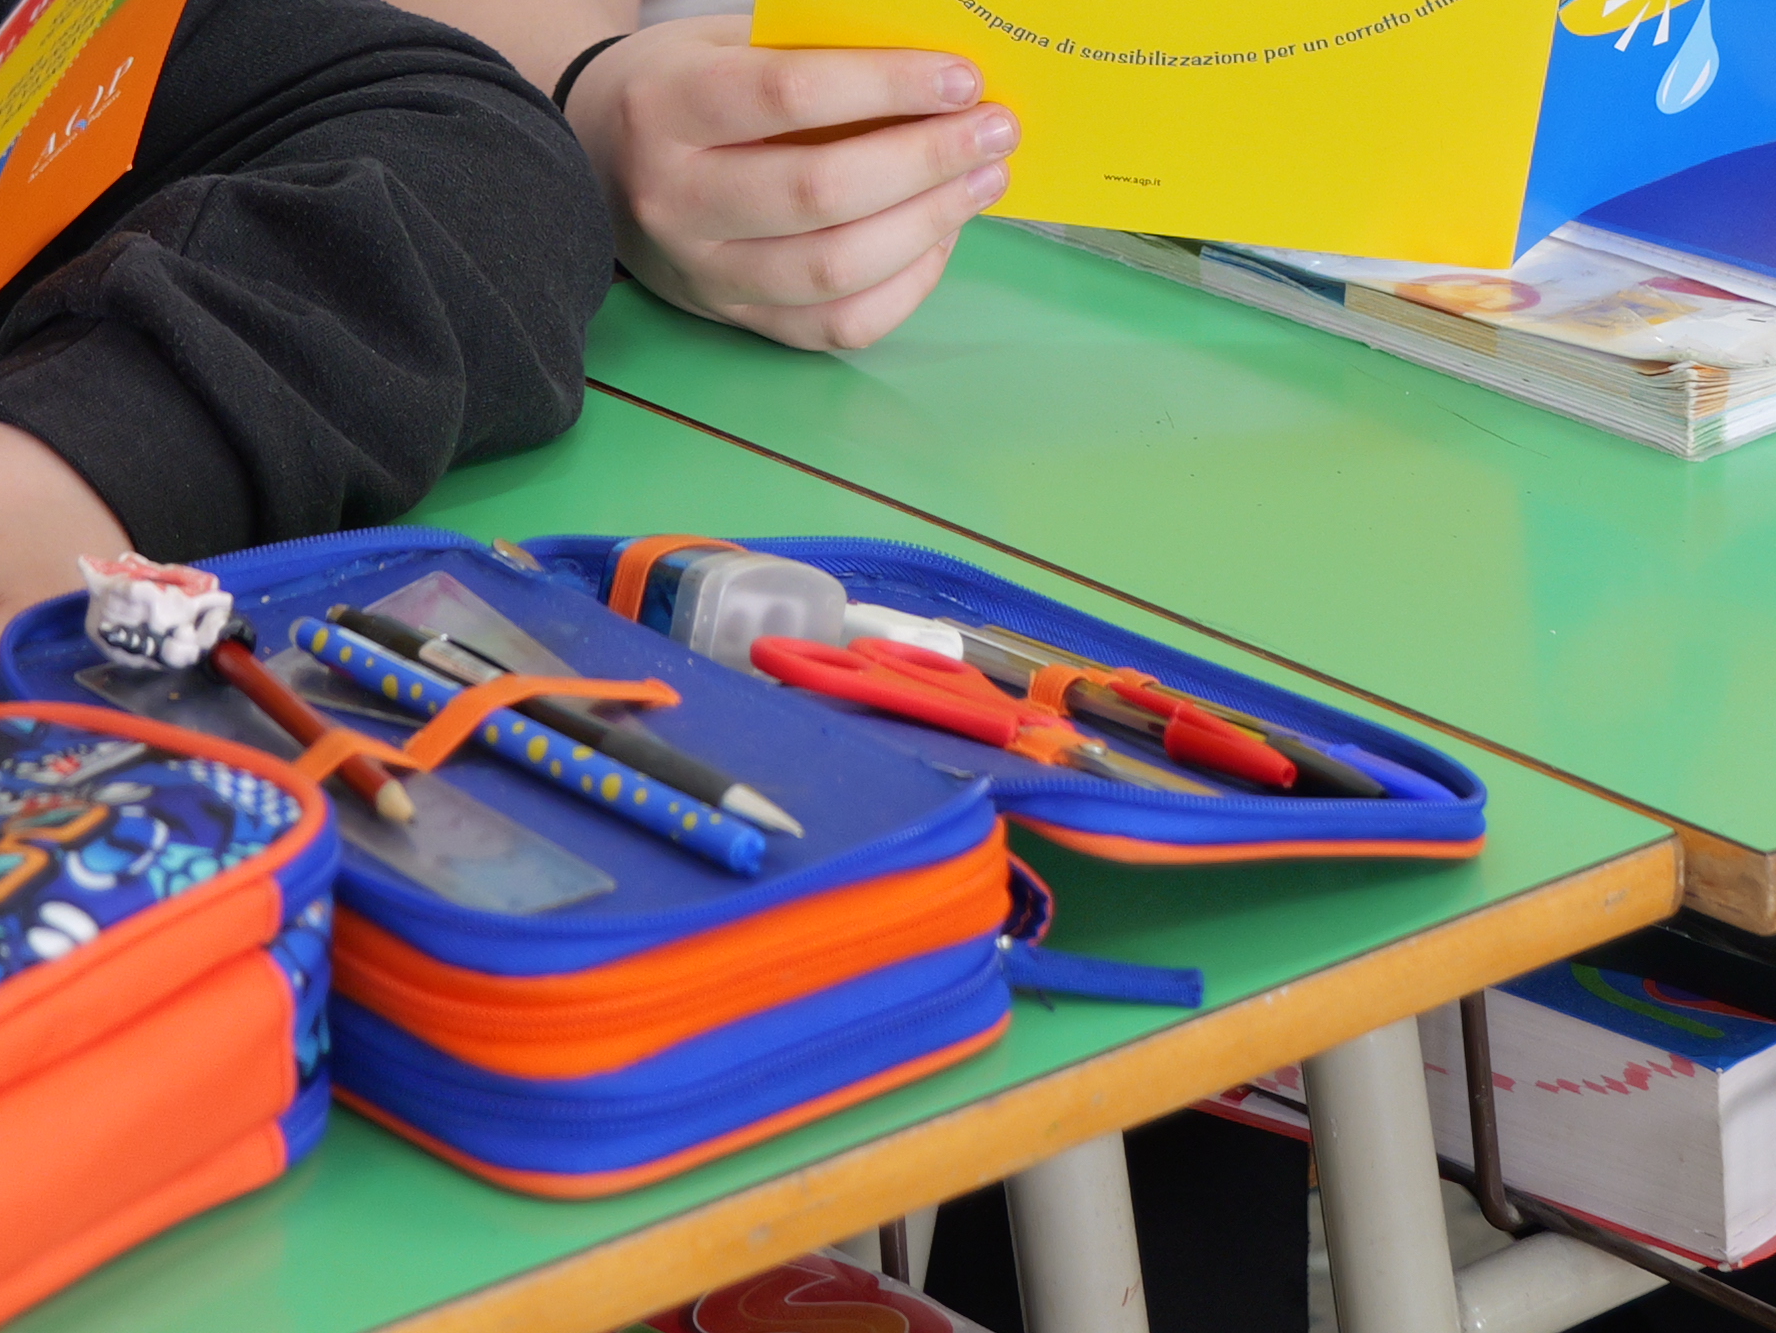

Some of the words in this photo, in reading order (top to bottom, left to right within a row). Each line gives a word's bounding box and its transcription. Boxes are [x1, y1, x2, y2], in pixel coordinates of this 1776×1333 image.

[1055, 37, 1076, 56] di
[1079, 44, 1259, 69] sensibilizzazione
[1263, 42, 1298, 65] per
[1302, 35, 1330, 54] un
[1334, 9, 1412, 49] corretto
[1103, 172, 1162, 189] www.aqp.it
